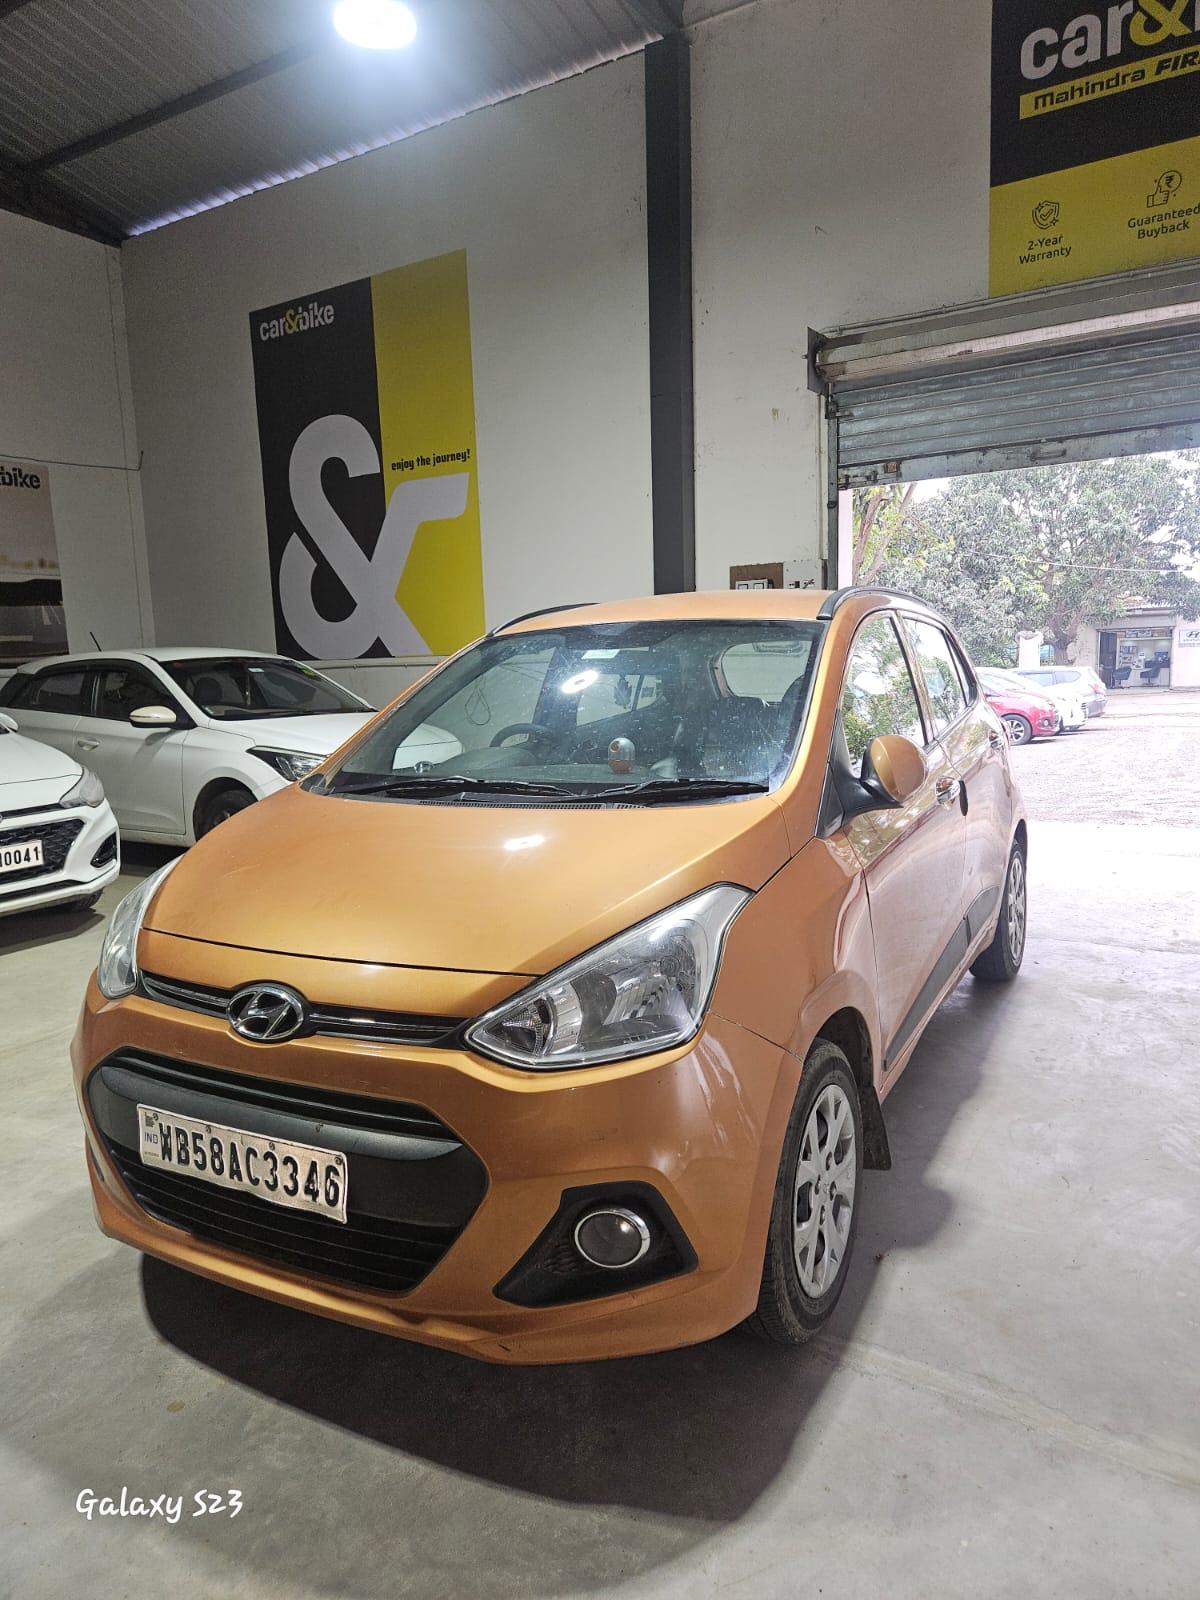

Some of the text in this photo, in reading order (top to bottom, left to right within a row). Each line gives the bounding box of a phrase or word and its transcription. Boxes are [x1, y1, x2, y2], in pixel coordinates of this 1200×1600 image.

[1020, 0, 1200, 80] car&
[1033, 50, 1200, 111] Mahindra FIR
[1127, 203, 1200, 229] Guaranteed
[1137, 219, 1190, 240] Buyback
[1027, 234, 1064, 251] 2-Year
[1019, 246, 1072, 265] Warranty
[259, 302, 336, 341] car&bike
[391, 448, 471, 472] enjoy the journey!
[144, 1131, 159, 1145] IND
[158, 1121, 340, 1208] WB58AC3346
